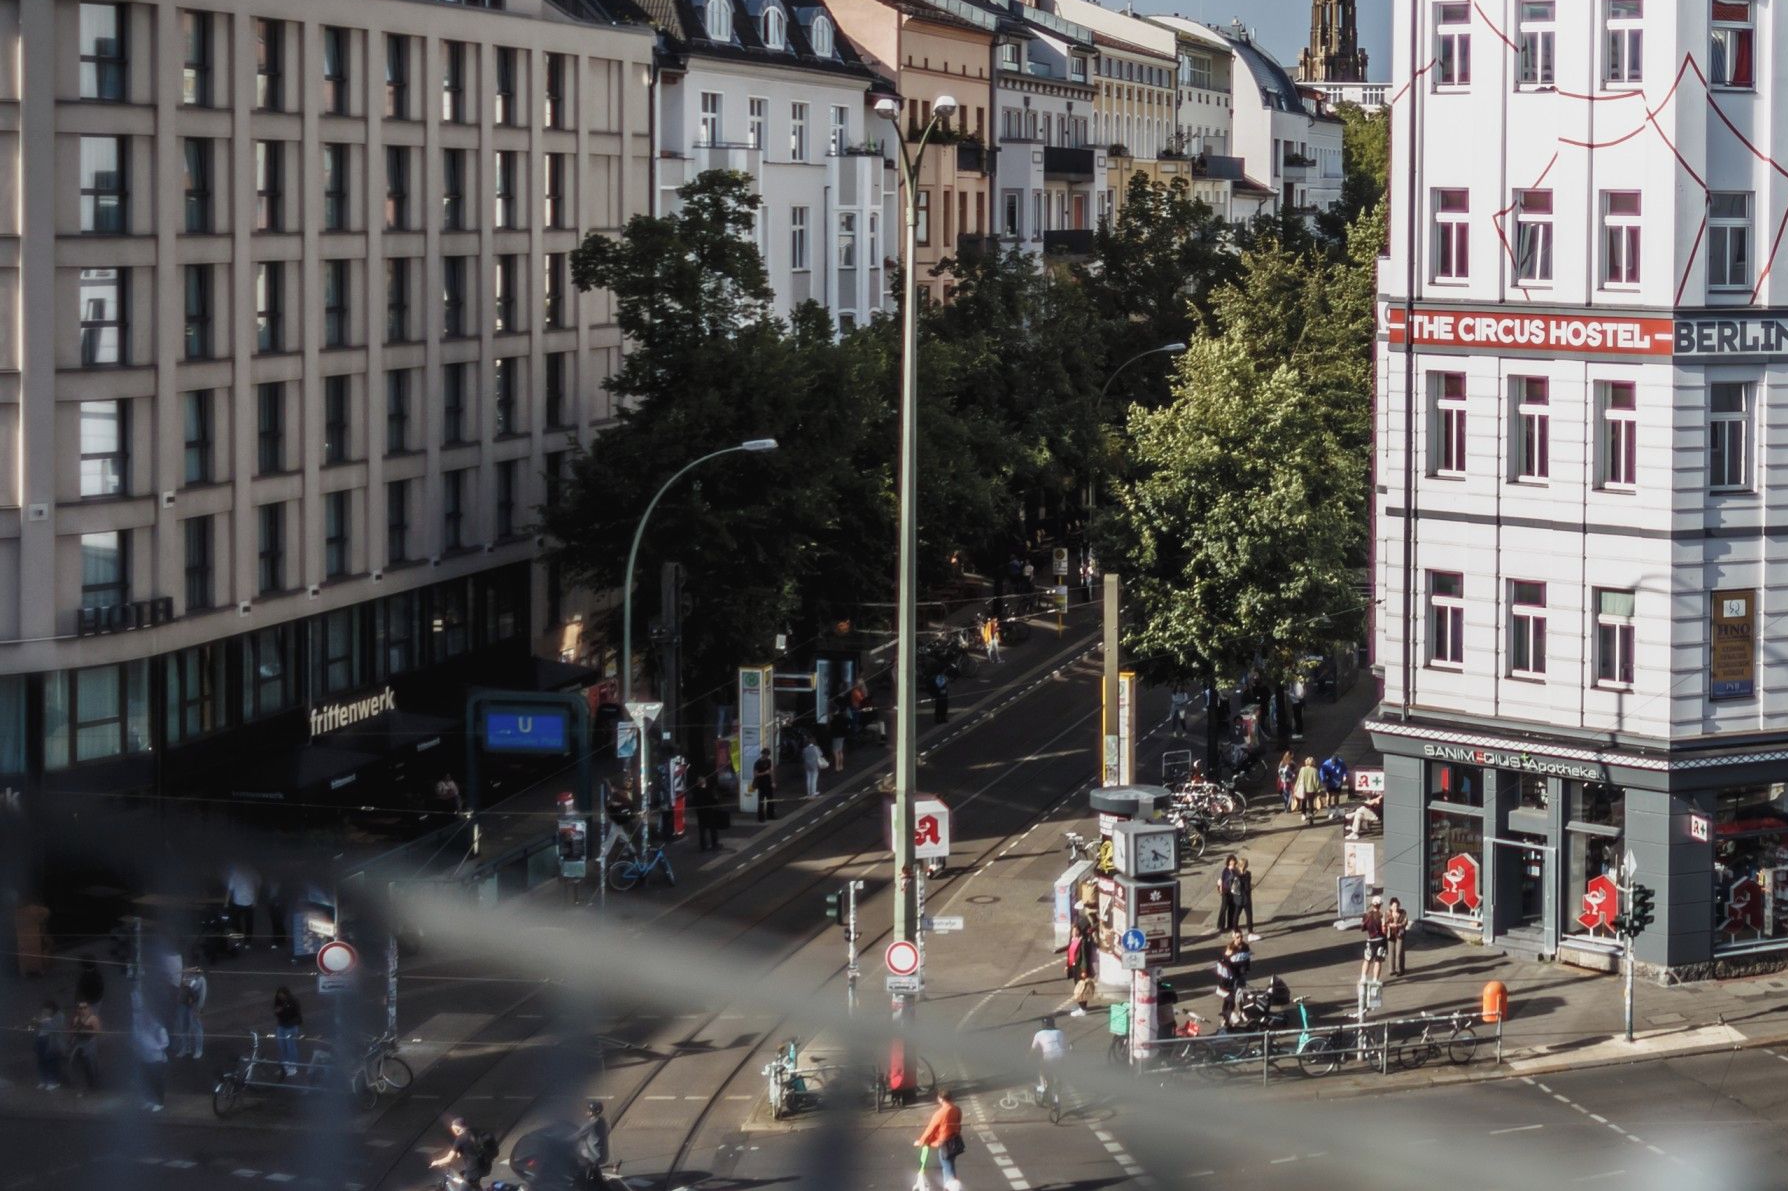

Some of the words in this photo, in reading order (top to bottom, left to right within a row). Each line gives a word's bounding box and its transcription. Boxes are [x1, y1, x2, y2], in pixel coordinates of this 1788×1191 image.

[1411, 315, 1454, 341] THE
[1458, 316, 1546, 345] CIRCUS
[1550, 320, 1650, 349] HOSTEL
[310, 686, 395, 736] frittenwerk
[518, 716, 532, 733] U
